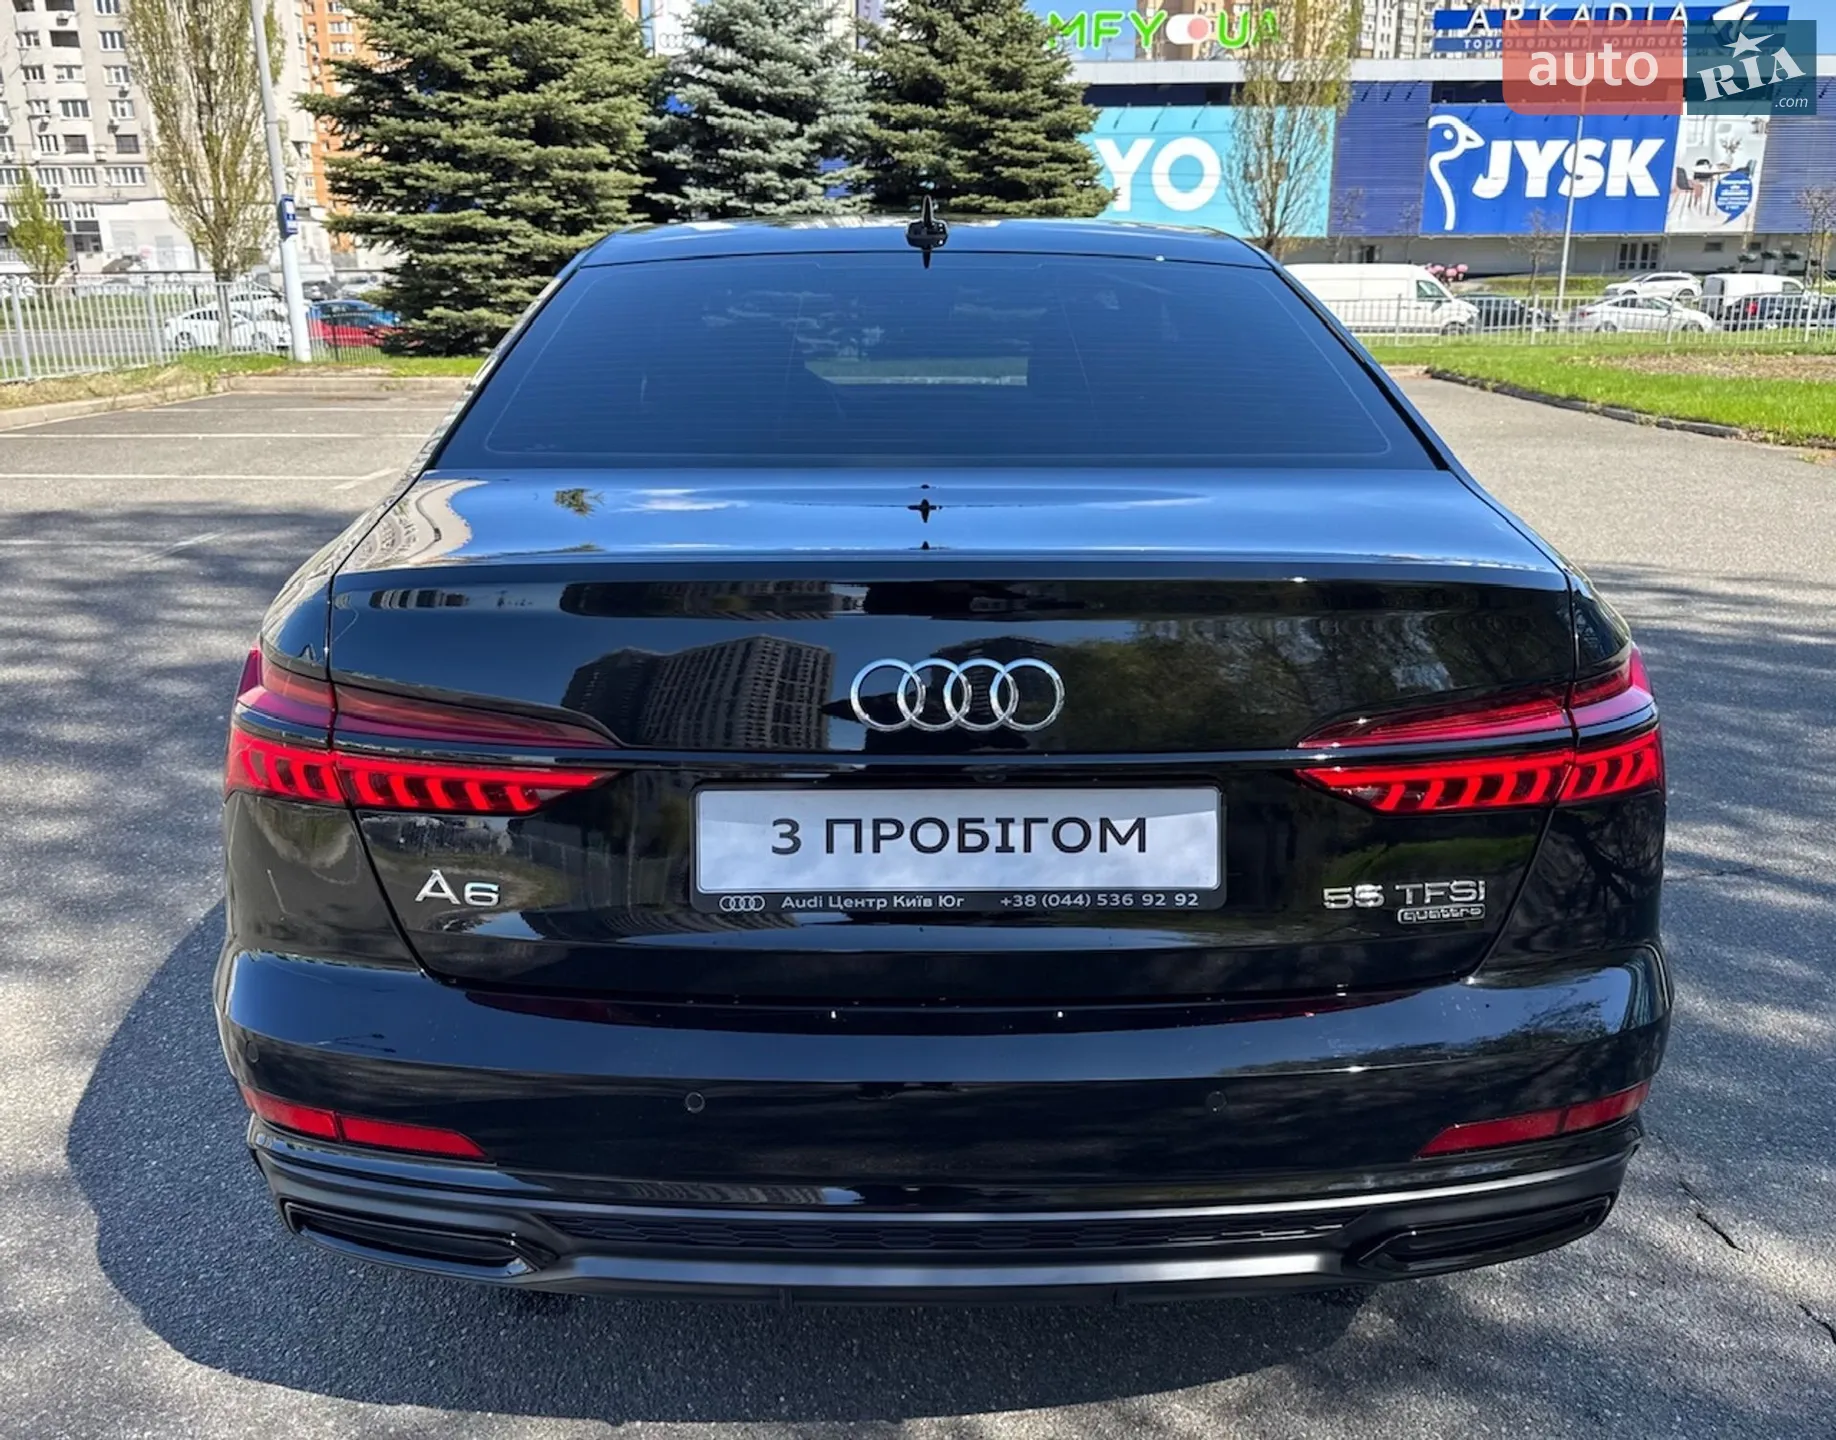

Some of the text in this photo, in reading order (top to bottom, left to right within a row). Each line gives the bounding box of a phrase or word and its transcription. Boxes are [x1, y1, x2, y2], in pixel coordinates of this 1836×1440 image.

[1048, 10, 1168, 49] MFY
[1465, 2, 1689, 34] ARKADIA
[1472, 138, 1665, 198] JYSK
[826, 817, 1146, 854] ПРОБІГОМ
[415, 869, 499, 906] A6
[781, 895, 964, 911] Audi Центр Київ Юг
[1000, 893, 1198, 909] +38 (044) 536 92 92
[1402, 906, 1483, 923] quattro
